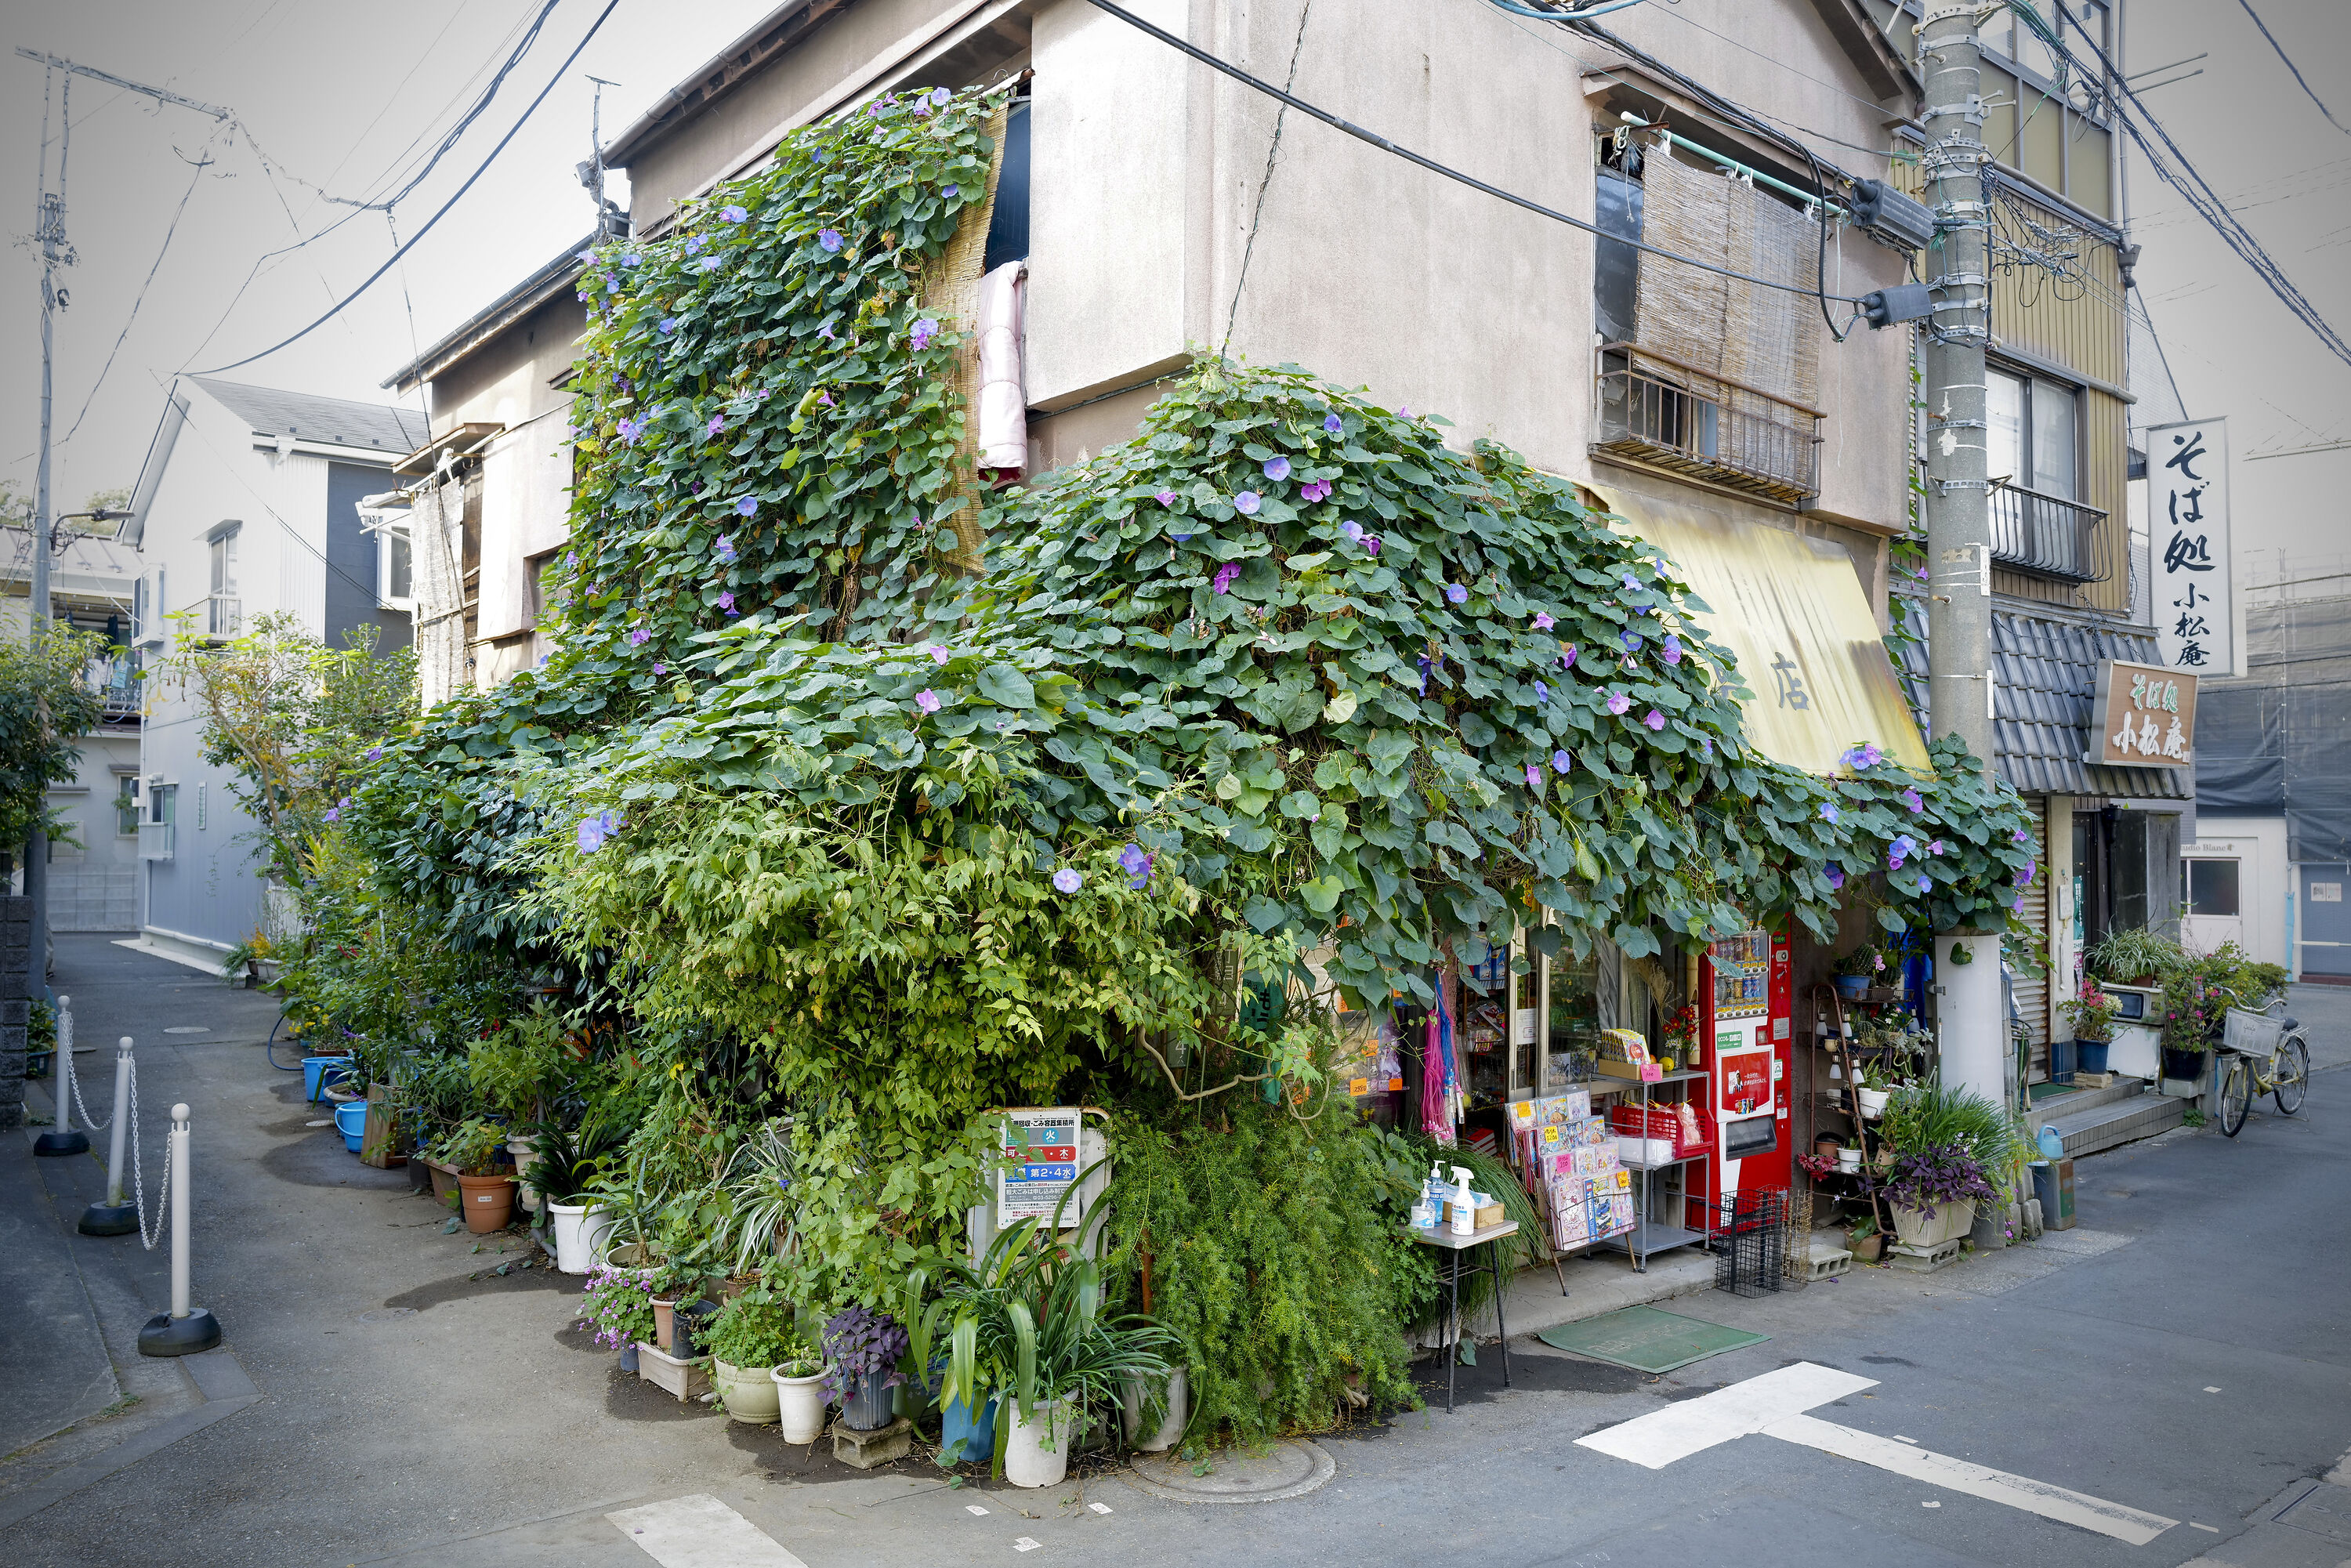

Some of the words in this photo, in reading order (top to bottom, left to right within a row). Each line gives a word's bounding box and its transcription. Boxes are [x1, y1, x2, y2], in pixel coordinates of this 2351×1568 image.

[2164, 431, 2216, 574] そば処
[2173, 583, 2211, 666] 小松庵
[2130, 673, 2179, 713] そば処
[2112, 712, 2186, 760] 小松庵
[1045, 1129, 1056, 1140] 火
[1031, 1168, 1071, 1178] 第2・4水
